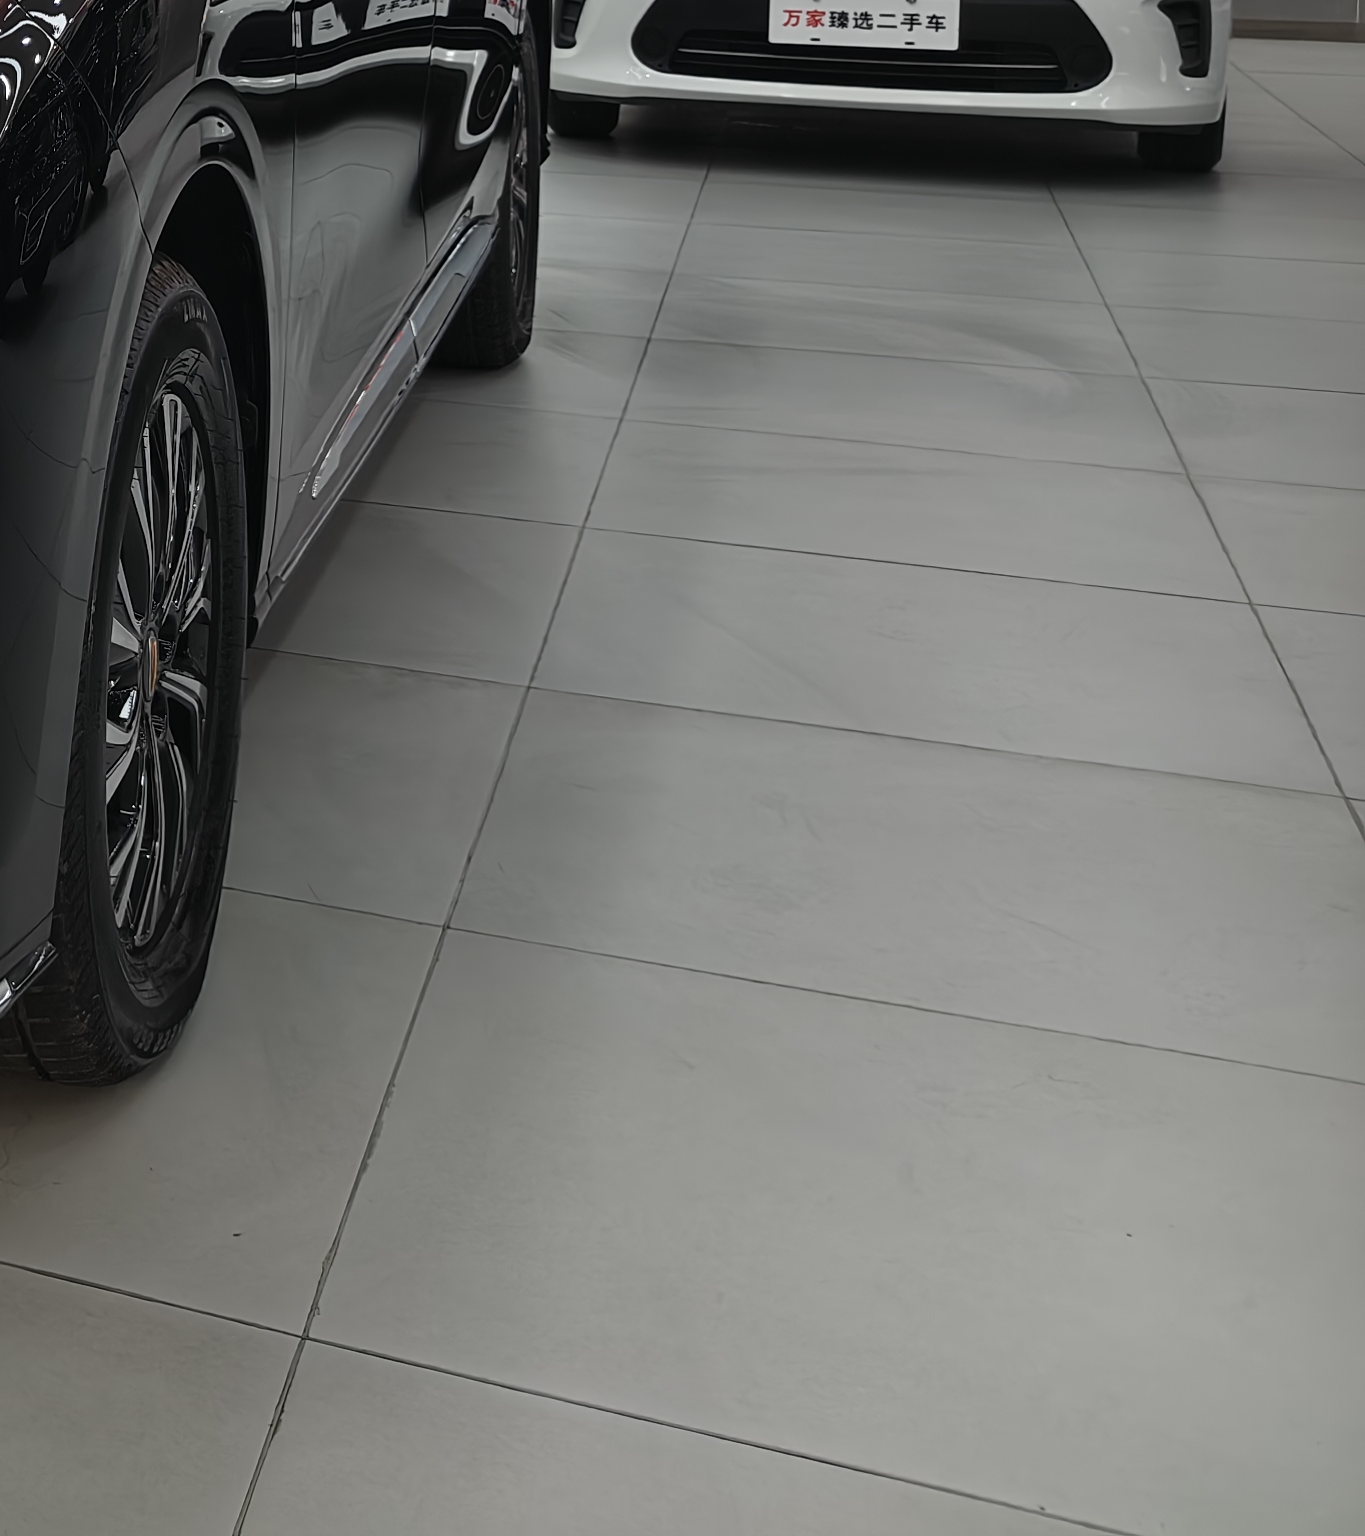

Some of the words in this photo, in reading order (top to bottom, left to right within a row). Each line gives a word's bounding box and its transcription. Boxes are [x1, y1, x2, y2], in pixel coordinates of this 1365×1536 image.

[782, 9, 947, 33] 万家臻选二手车
